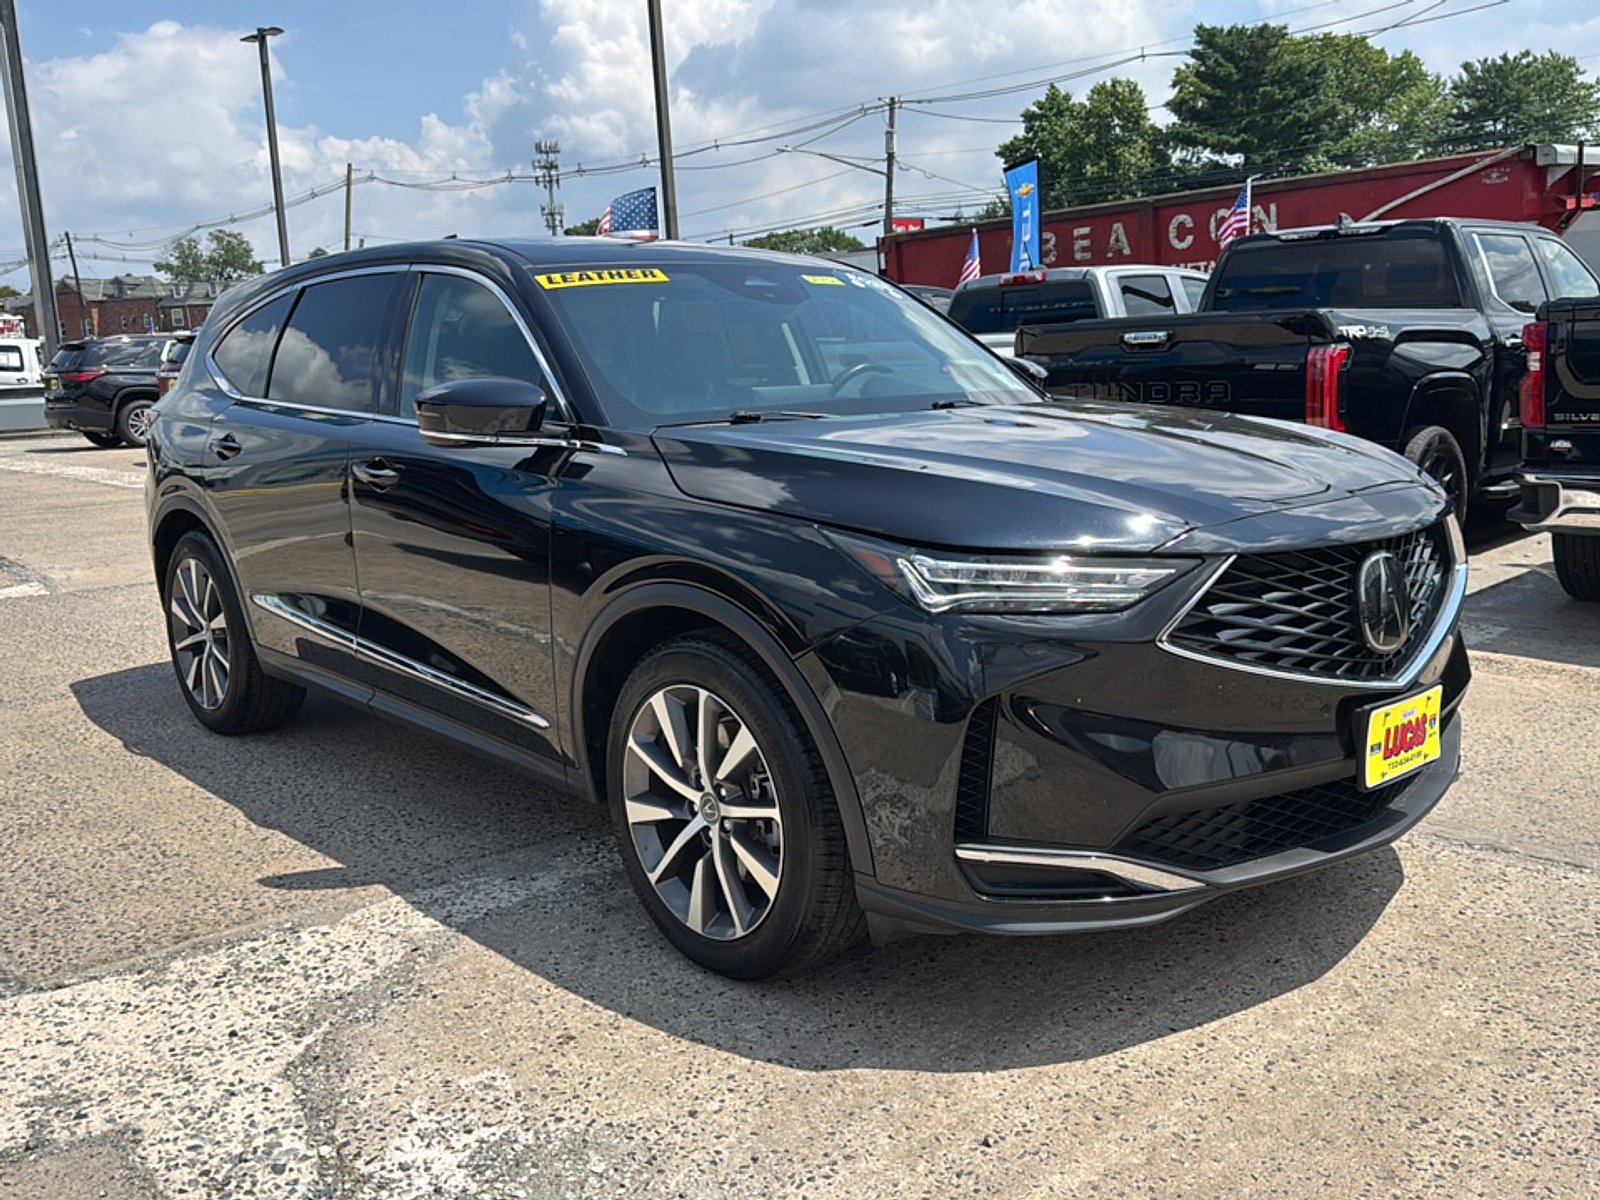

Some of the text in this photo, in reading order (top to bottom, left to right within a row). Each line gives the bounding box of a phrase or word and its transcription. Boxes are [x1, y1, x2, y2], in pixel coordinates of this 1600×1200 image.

[546, 270, 660, 285] LEATHER
[1338, 325, 1367, 340] TRD
[1067, 380, 1231, 403] TUNDRA
[1383, 713, 1428, 760] LUCAS
